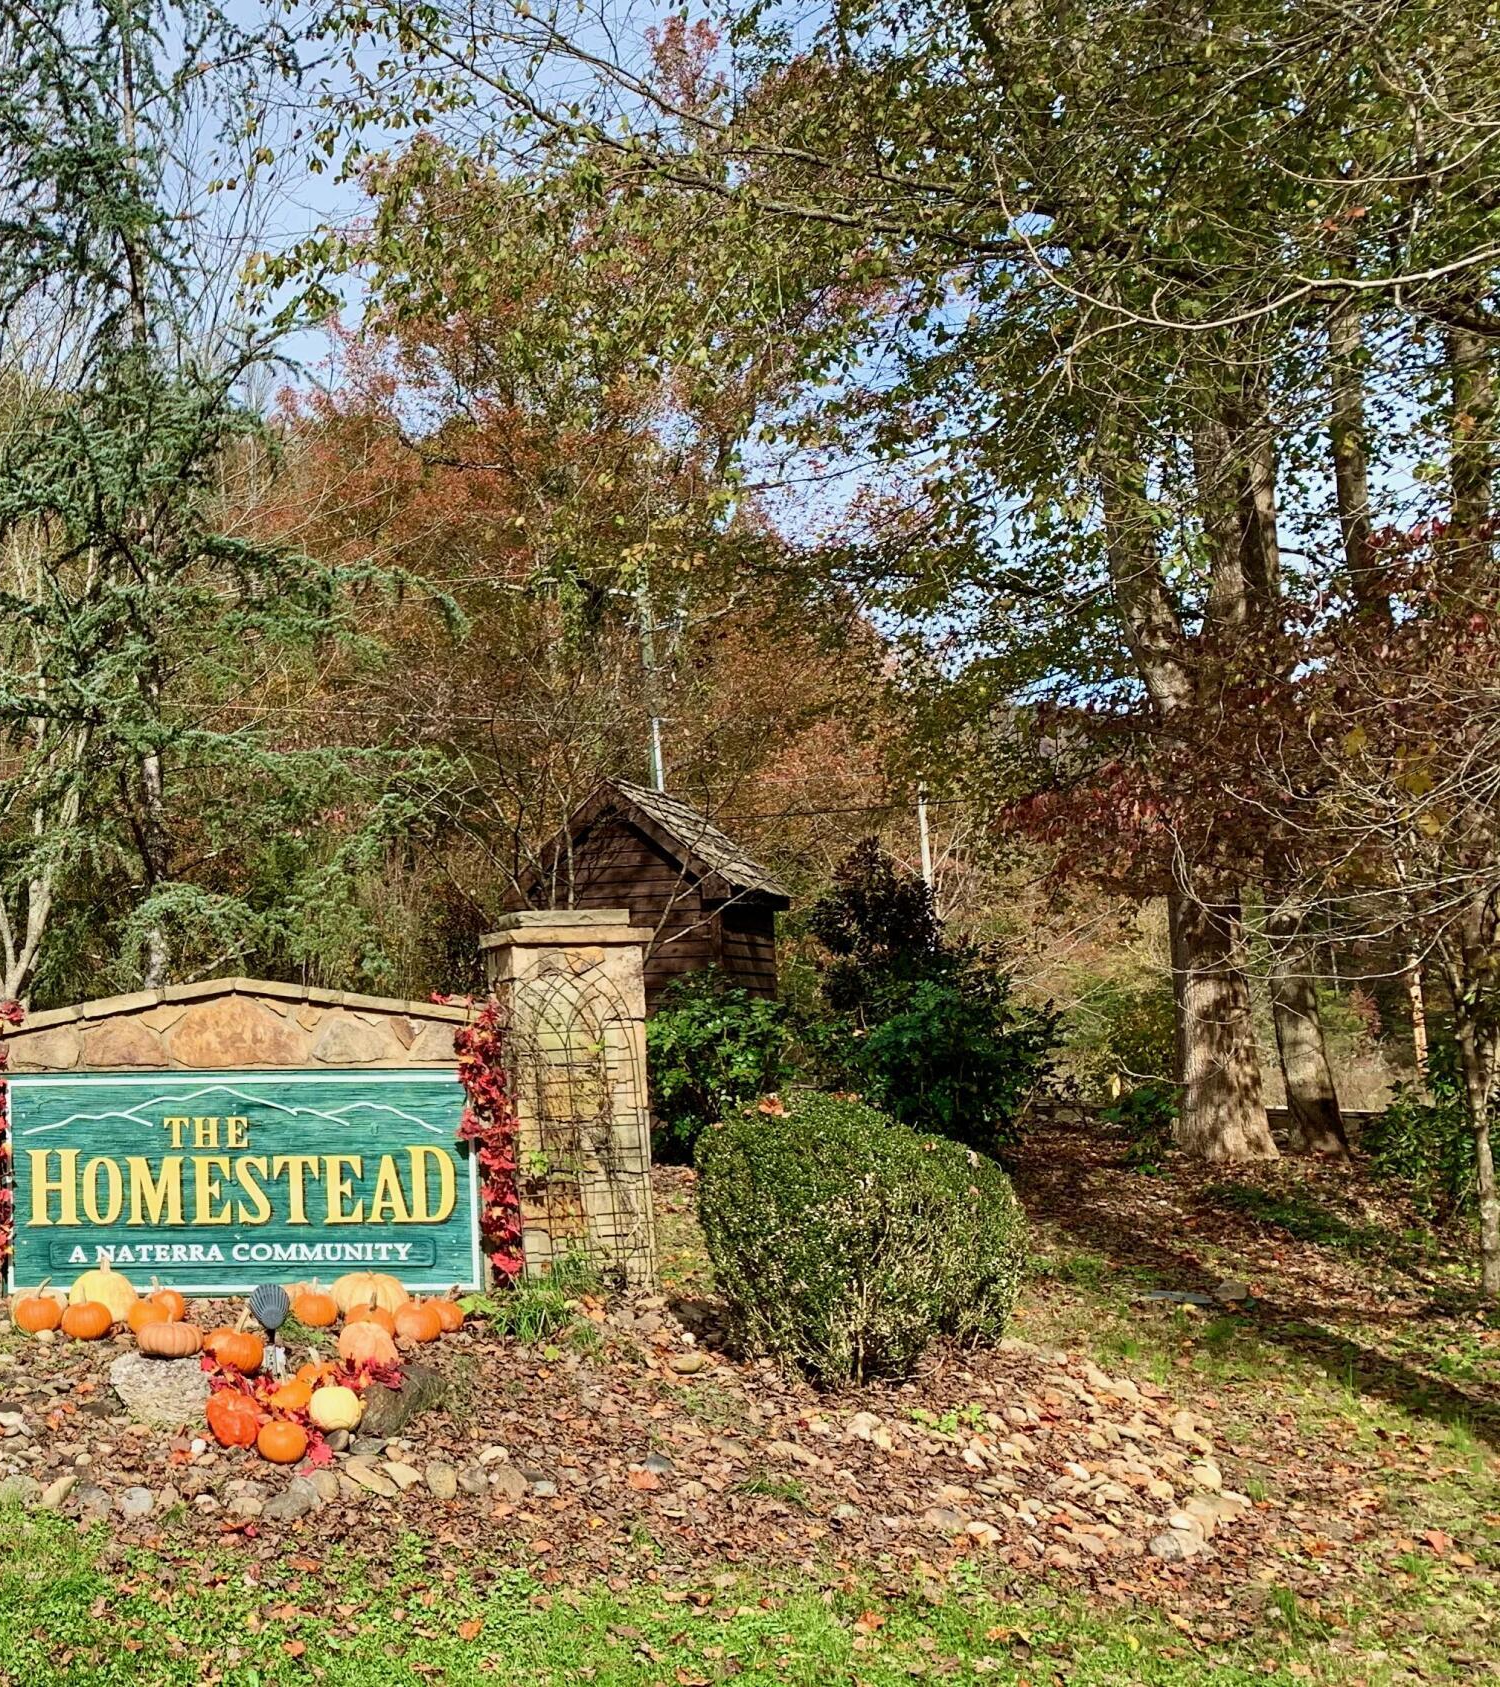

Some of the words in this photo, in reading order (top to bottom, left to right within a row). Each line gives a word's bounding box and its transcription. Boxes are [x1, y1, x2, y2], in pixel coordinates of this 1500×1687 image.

[164, 1116, 249, 1148] THE
[25, 1145, 458, 1227] HOMESTEAD
[69, 1245, 87, 1263] A
[95, 1244, 225, 1263] NATERRA
[231, 1241, 414, 1263] COMMUNITY
